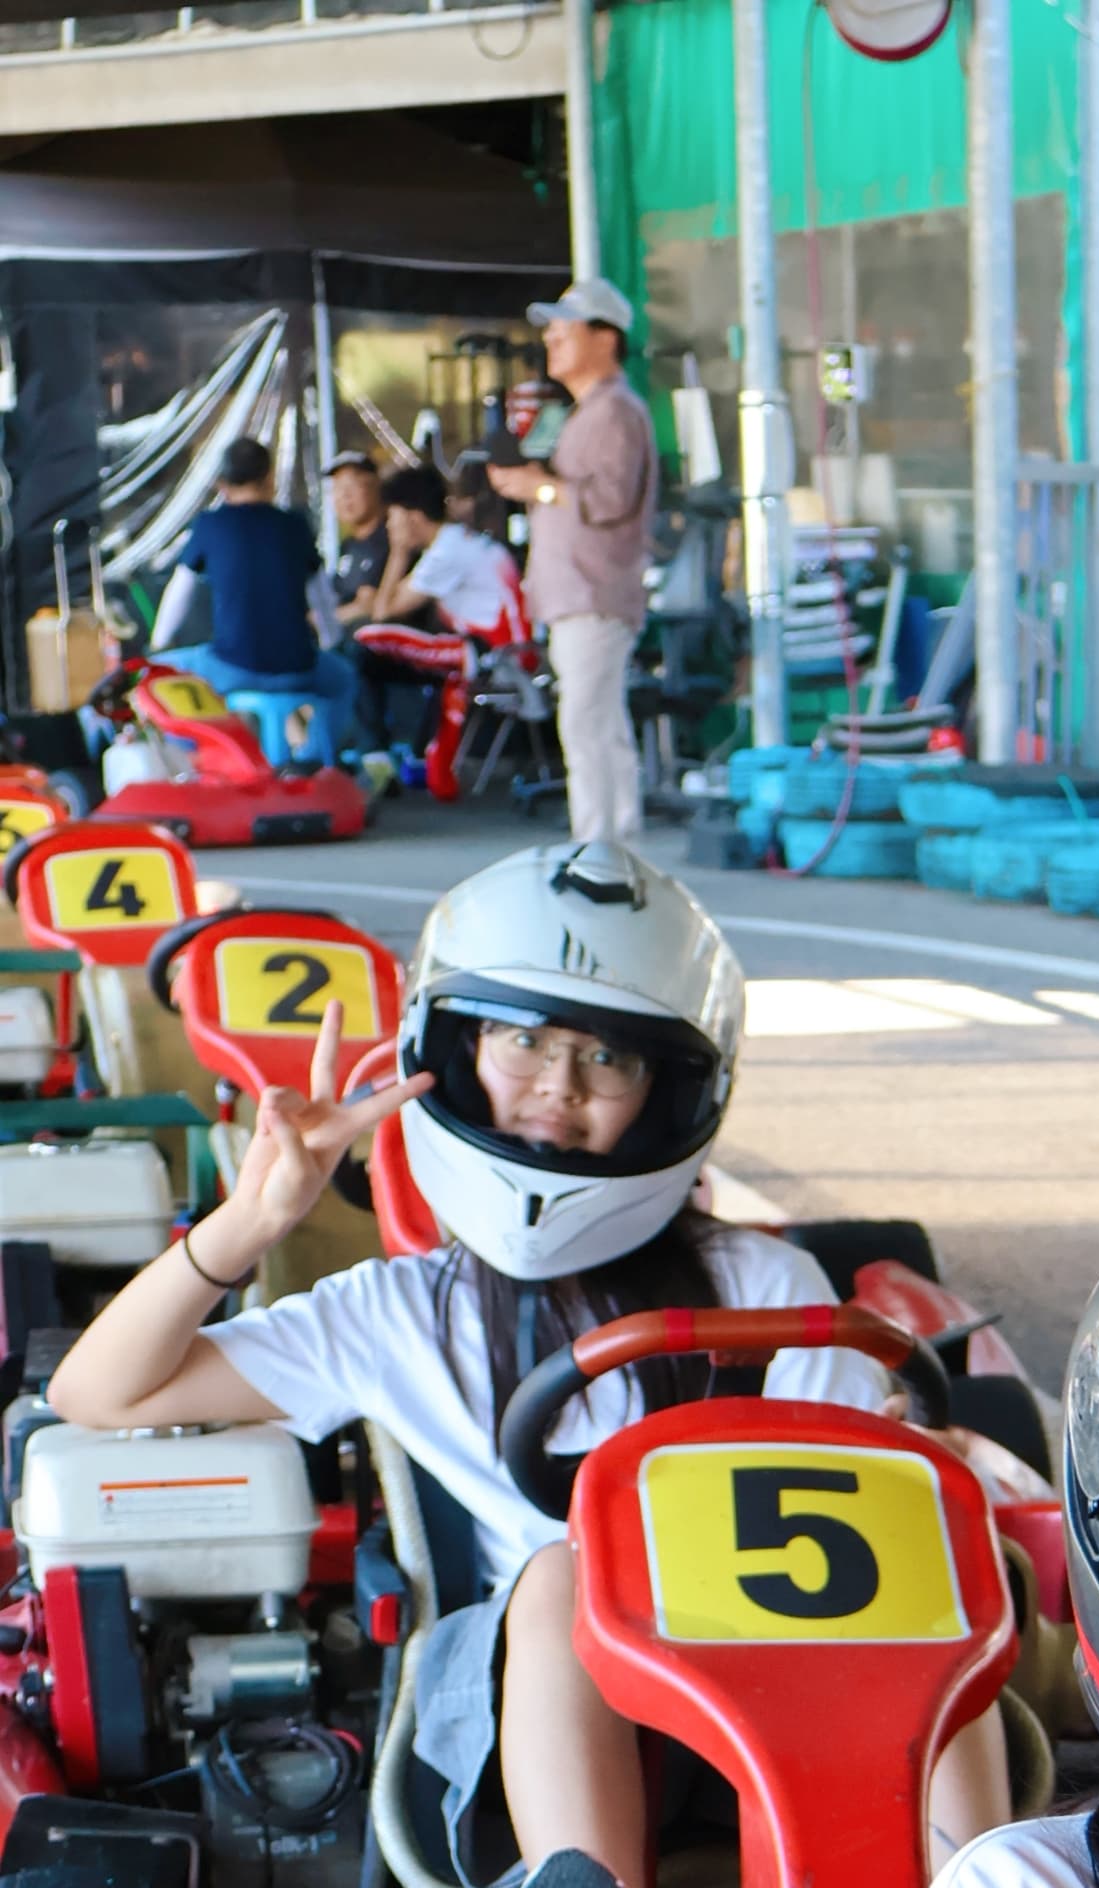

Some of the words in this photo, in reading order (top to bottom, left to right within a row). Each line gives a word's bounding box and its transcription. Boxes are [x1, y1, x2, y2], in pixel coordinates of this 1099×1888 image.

[85, 859, 146, 917] 4
[262, 952, 332, 1025] 2
[731, 1467, 880, 1620] 5
